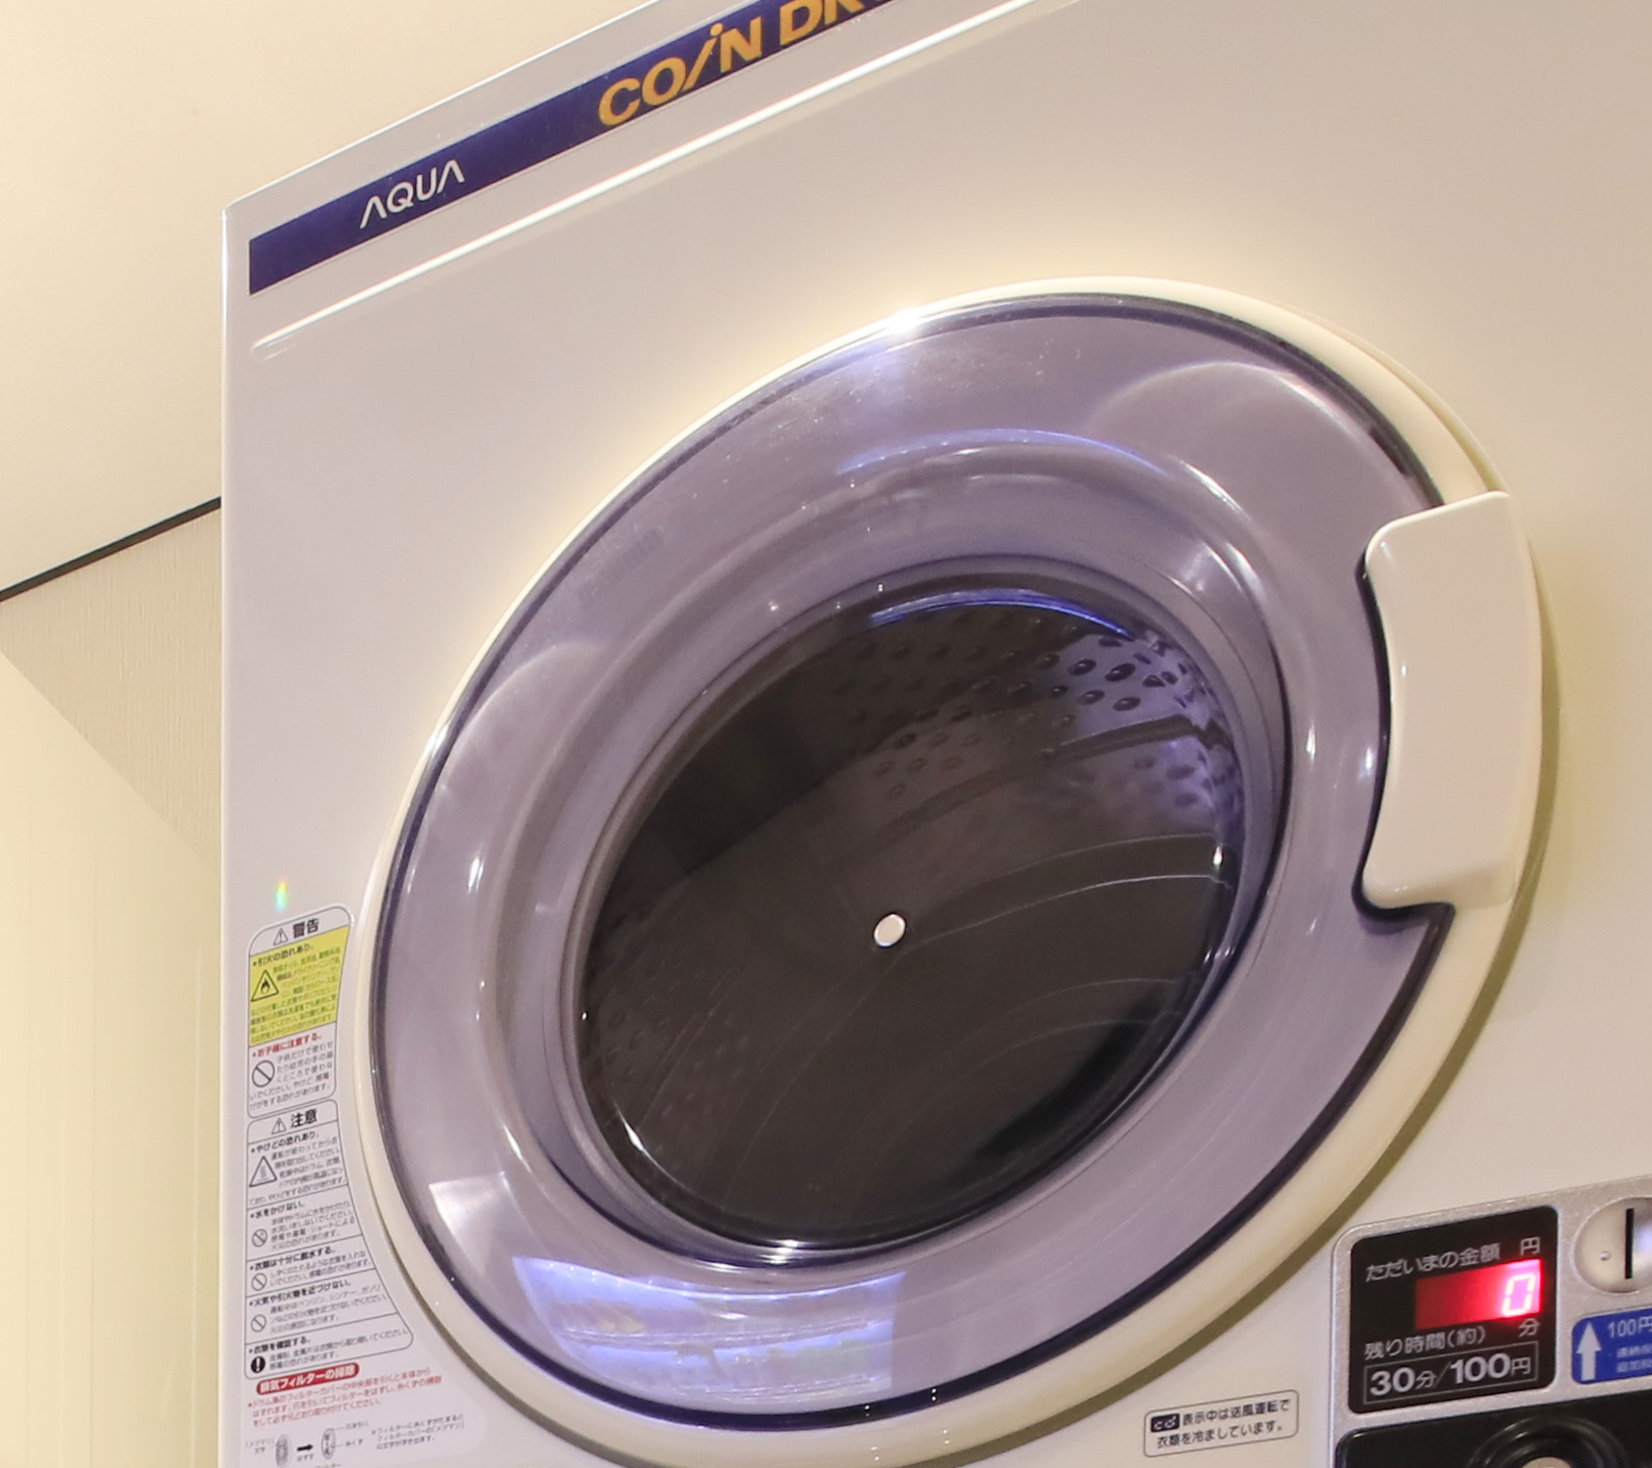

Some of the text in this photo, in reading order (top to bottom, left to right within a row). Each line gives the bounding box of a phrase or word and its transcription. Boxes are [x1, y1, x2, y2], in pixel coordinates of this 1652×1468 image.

[360, 159, 464, 229] AQUA
[598, 22, 762, 126] COIN
[290, 1108, 318, 1128] 注意
[1365, 1236, 1541, 1283] ただいまの金額 円
[1501, 1272, 1537, 1318] 0
[1364, 1316, 1541, 1361] 残り時間(約) 分
[1368, 1352, 1532, 1397] 30分/100円
[1157, 1419, 1284, 1449] 衣類を冷ましています。
[1182, 1398, 1292, 1426] 表示中は送風運転で
